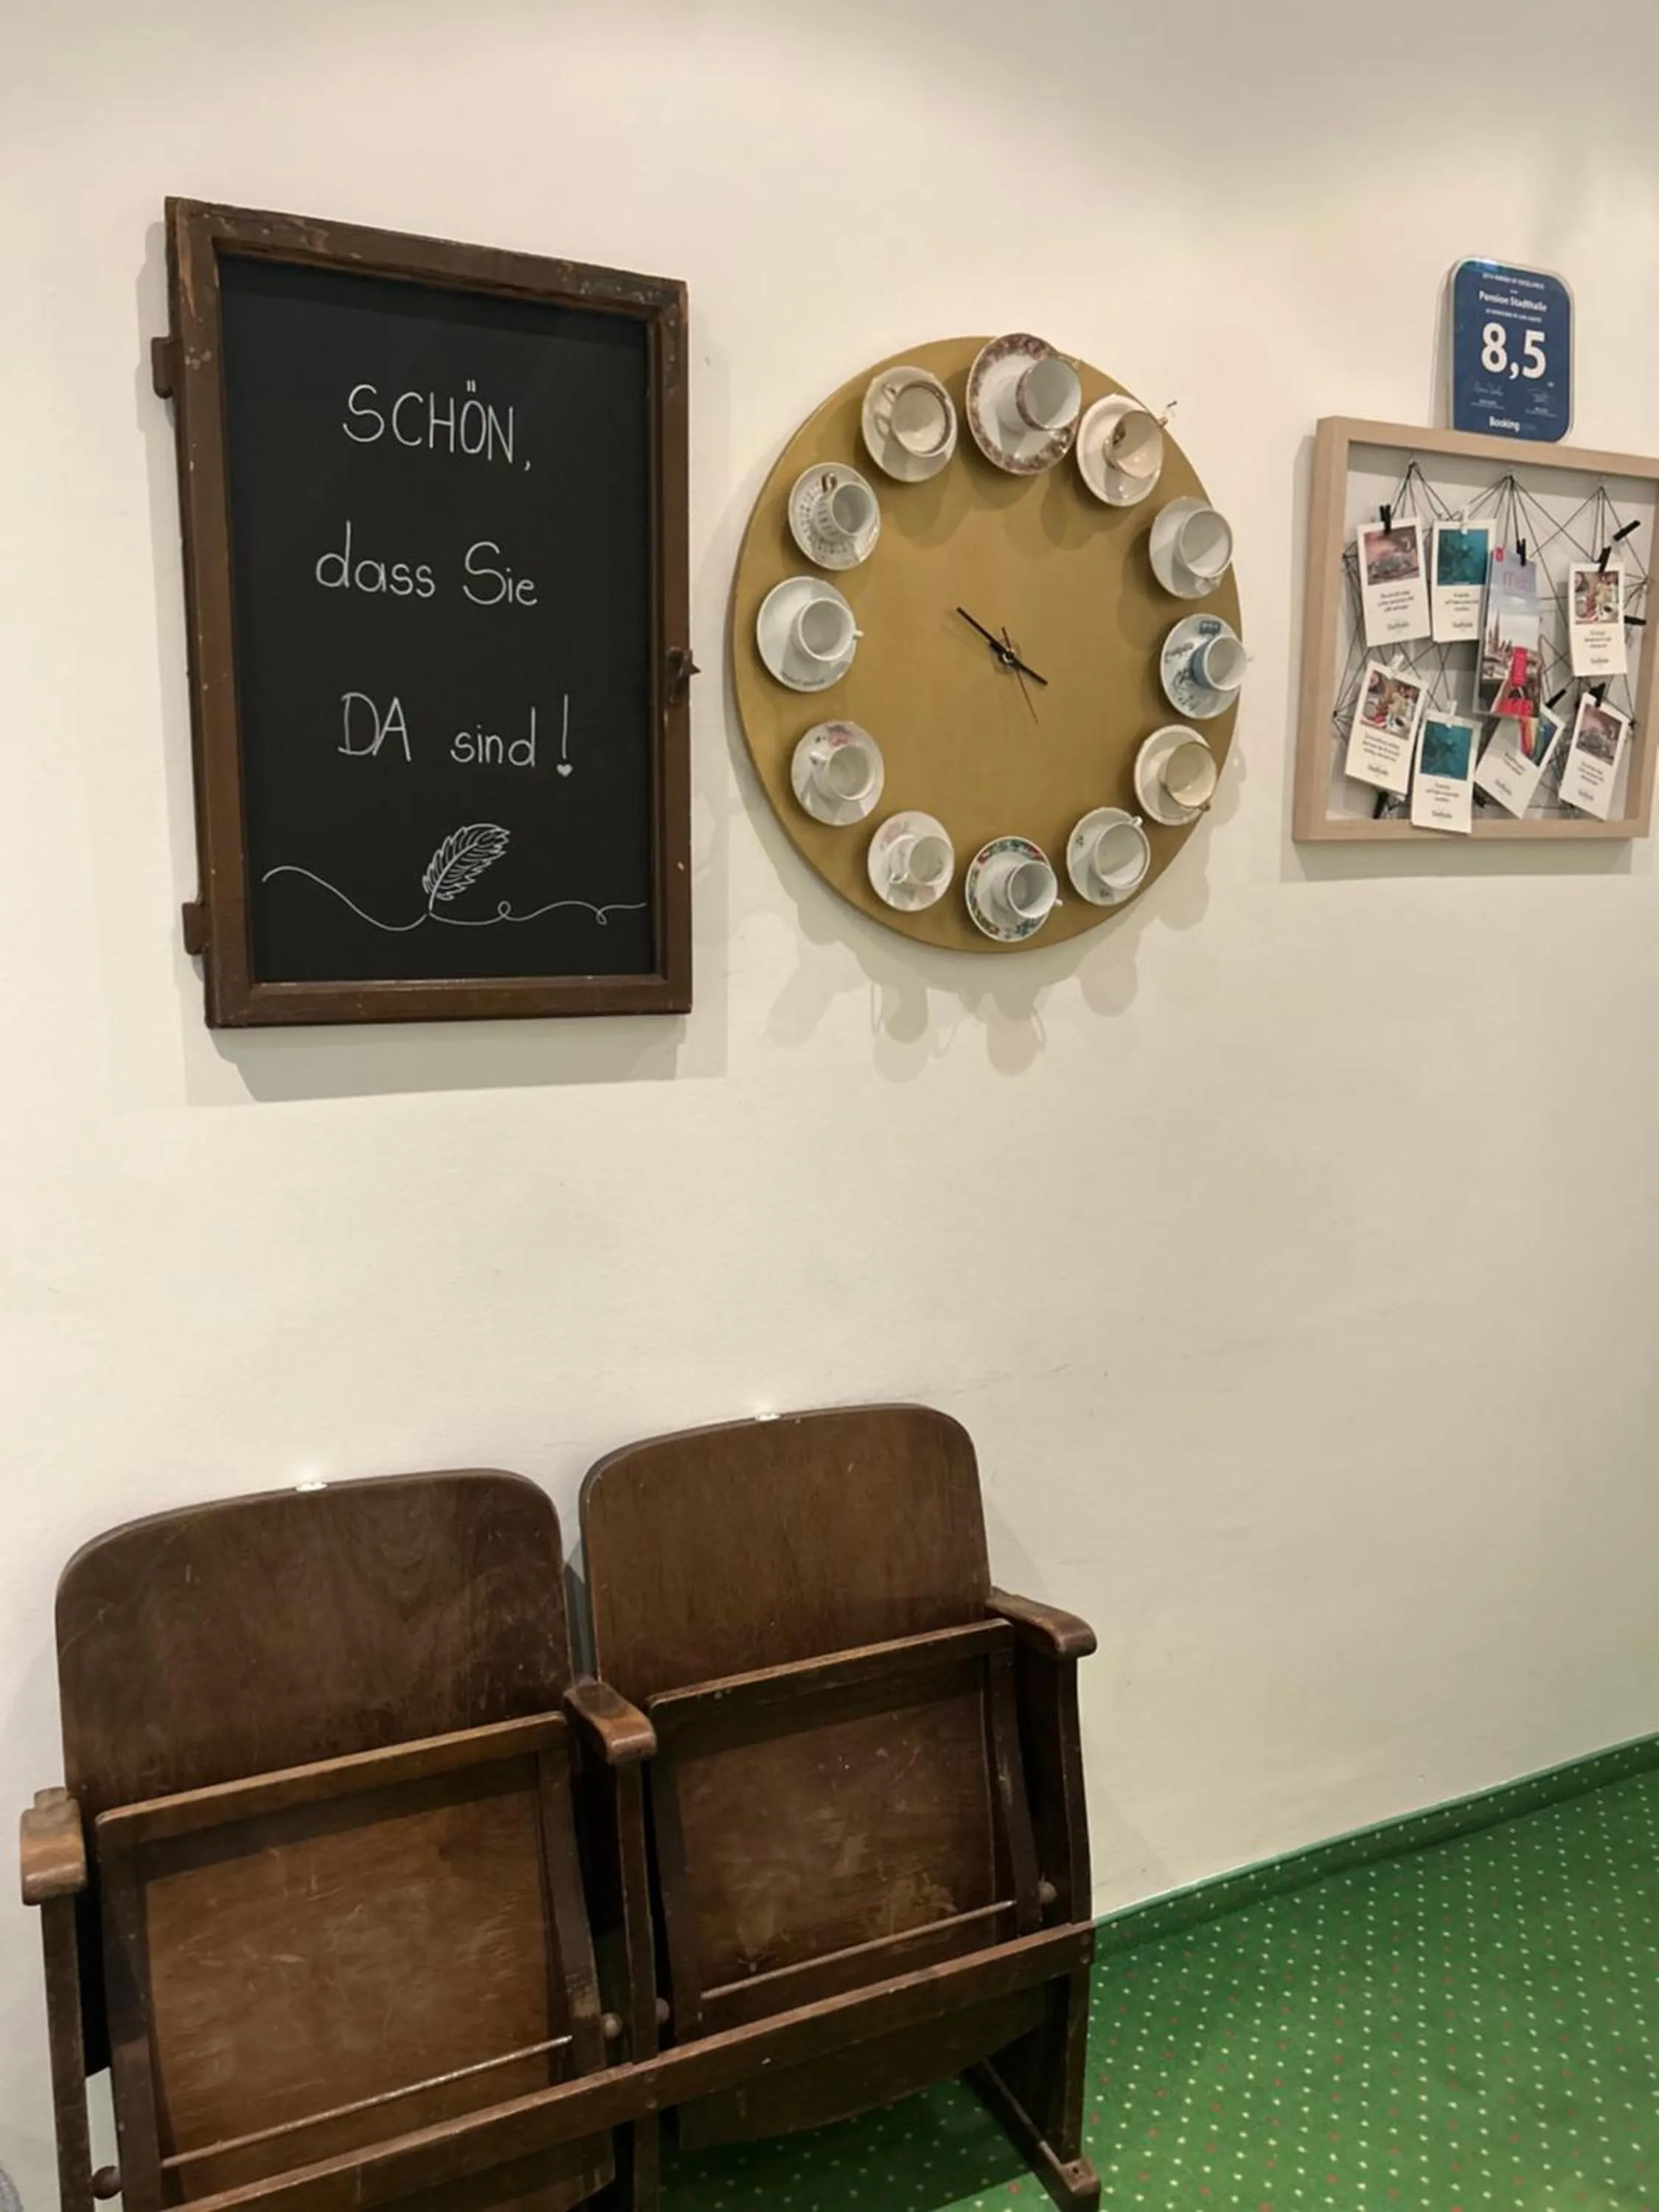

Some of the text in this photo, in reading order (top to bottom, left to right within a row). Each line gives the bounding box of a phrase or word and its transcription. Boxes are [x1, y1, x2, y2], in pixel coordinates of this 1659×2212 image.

[1481, 322, 1547, 380] 8,5
[342, 380, 532, 471] SCHÖN,
[1489, 415, 1520, 433] Booking
[316, 520, 538, 606] dass Sie
[338, 692, 411, 762] DA
